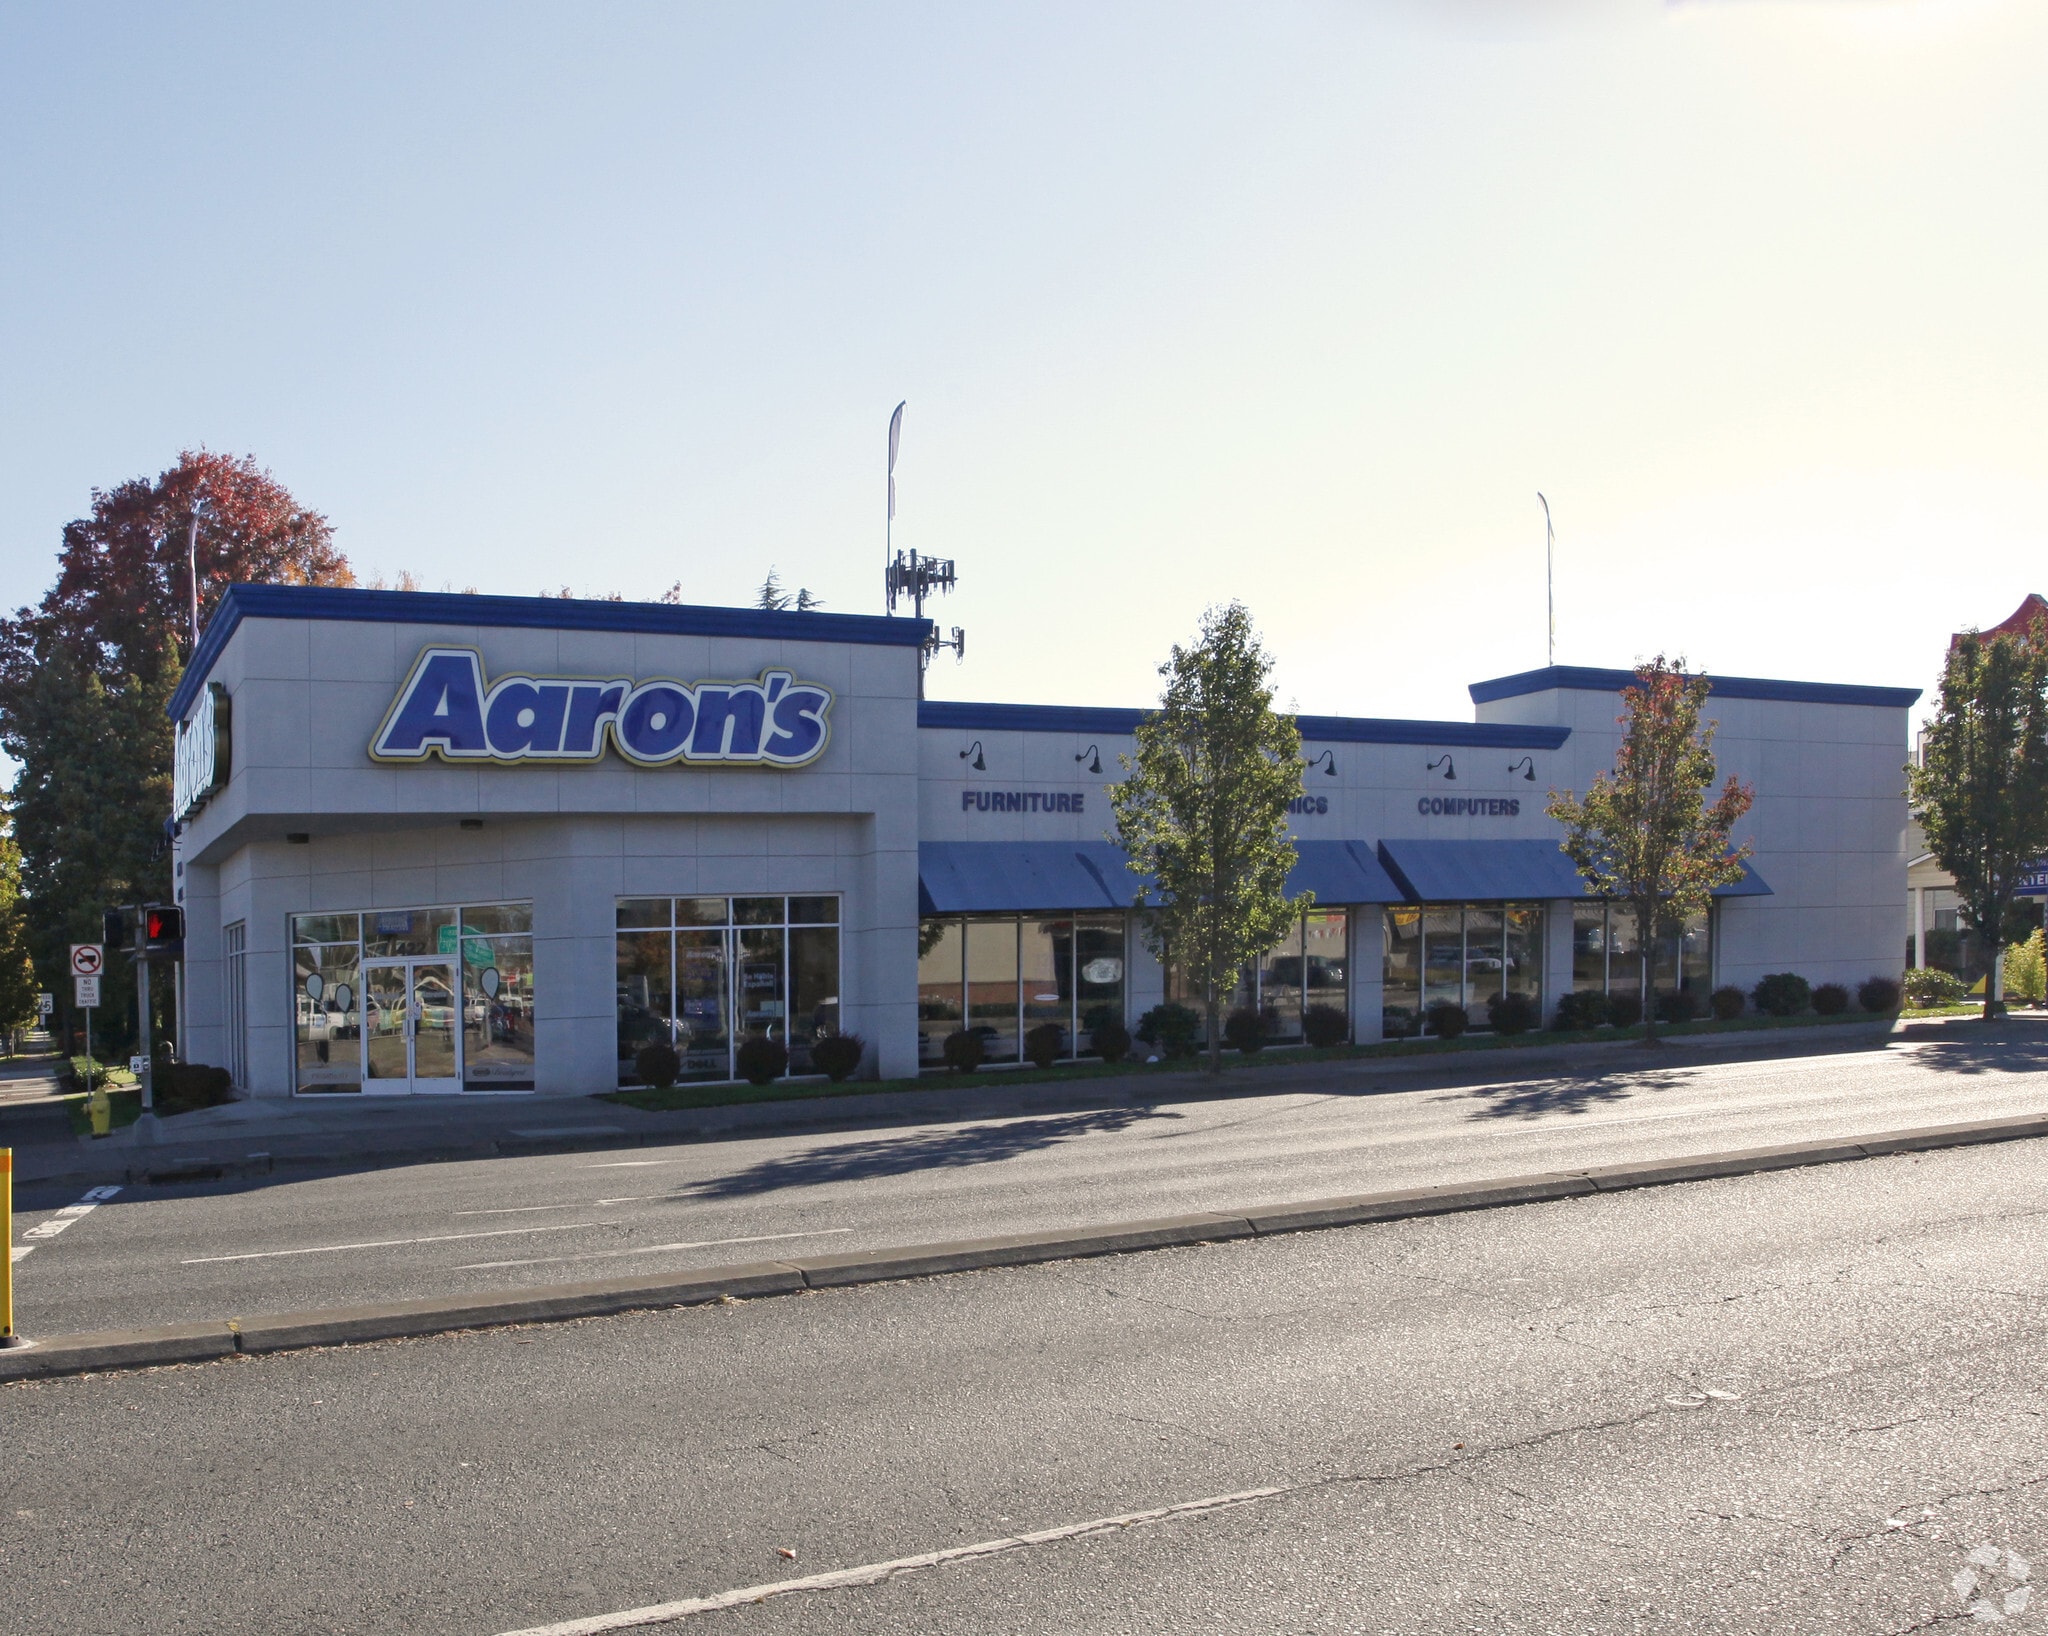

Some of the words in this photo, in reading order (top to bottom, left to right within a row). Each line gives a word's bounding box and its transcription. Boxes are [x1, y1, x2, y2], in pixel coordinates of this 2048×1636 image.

[375, 649, 832, 763] Aaron's
[962, 791, 1084, 813] FURNITURE
[1417, 797, 1520, 816] COMPUTERS
